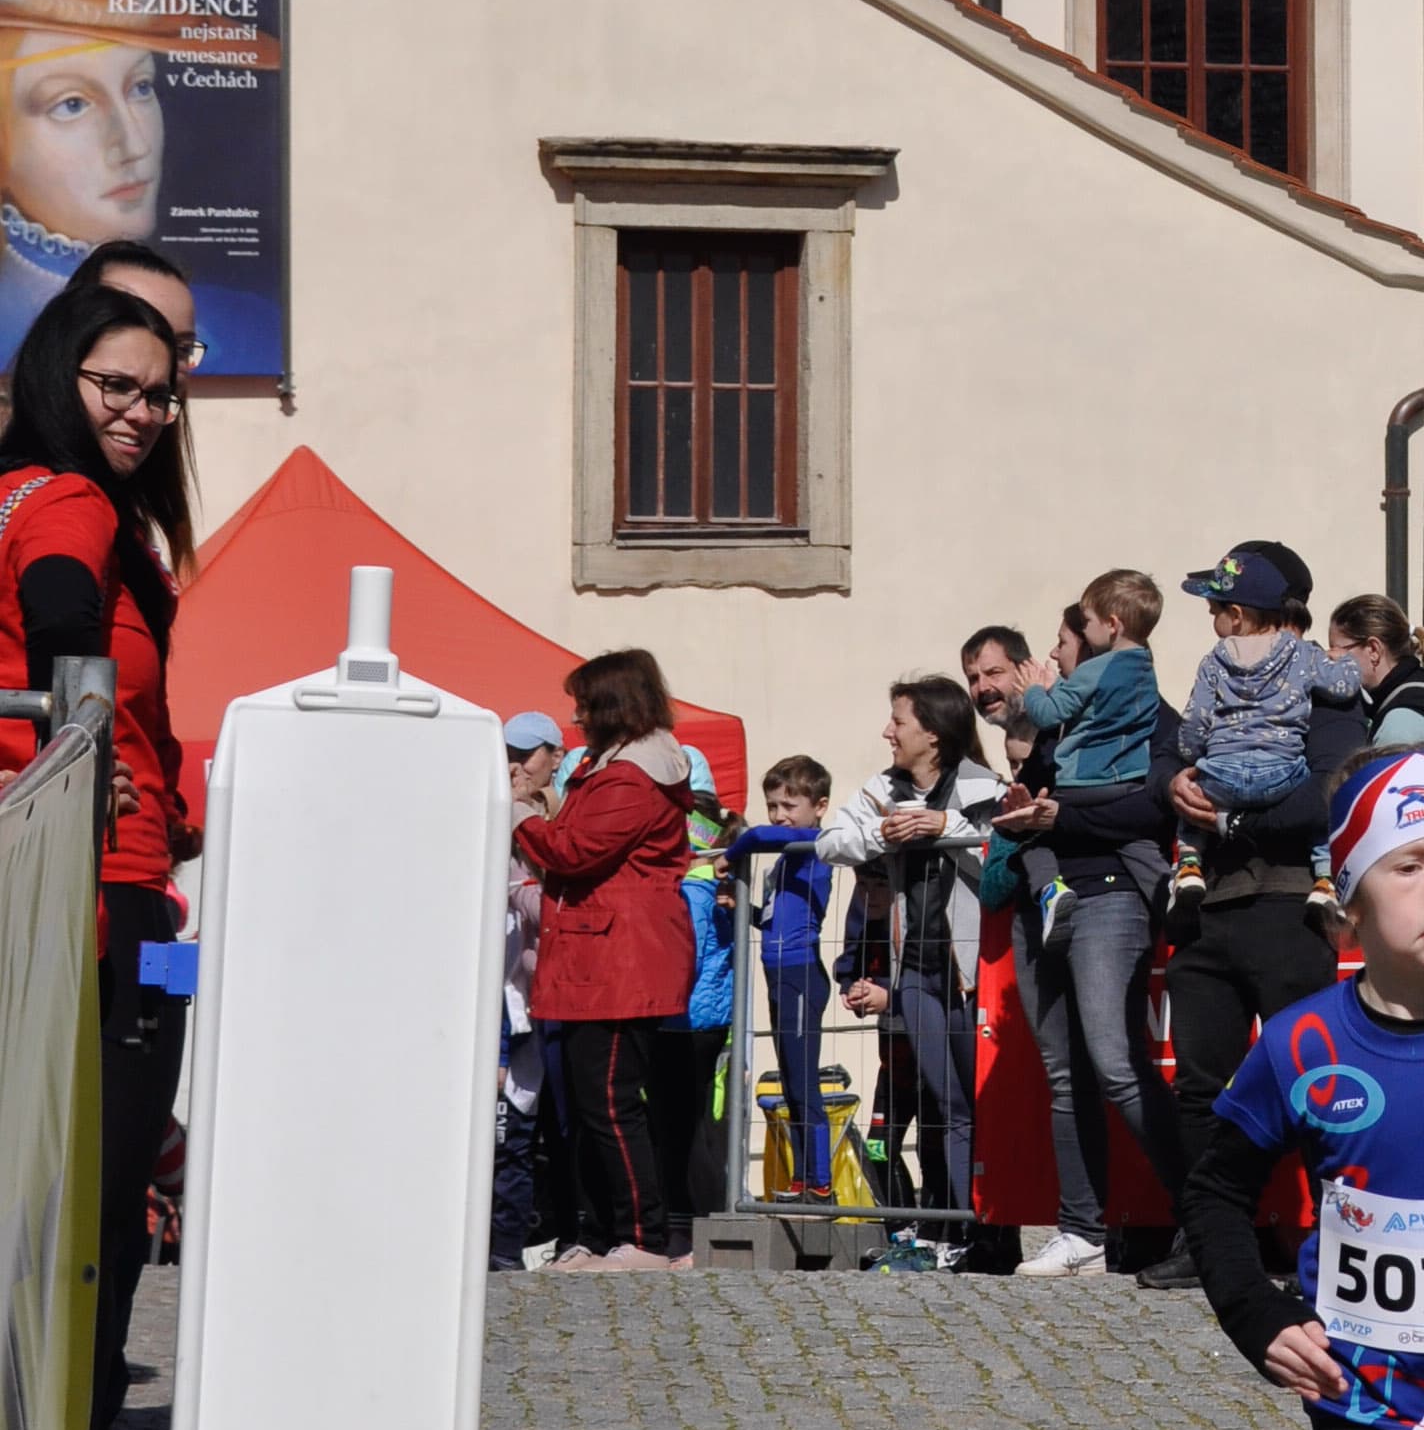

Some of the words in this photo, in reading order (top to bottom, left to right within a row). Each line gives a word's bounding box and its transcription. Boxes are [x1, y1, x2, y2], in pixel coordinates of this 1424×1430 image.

[180, 23, 258, 43] nejstarší
[168, 49, 258, 65] renesance
[166, 73, 179, 86] v
[182, 67, 258, 88] Čechách
[1332, 1098, 1364, 1111] ATEX
[1343, 1319, 1373, 1336] PVZP
